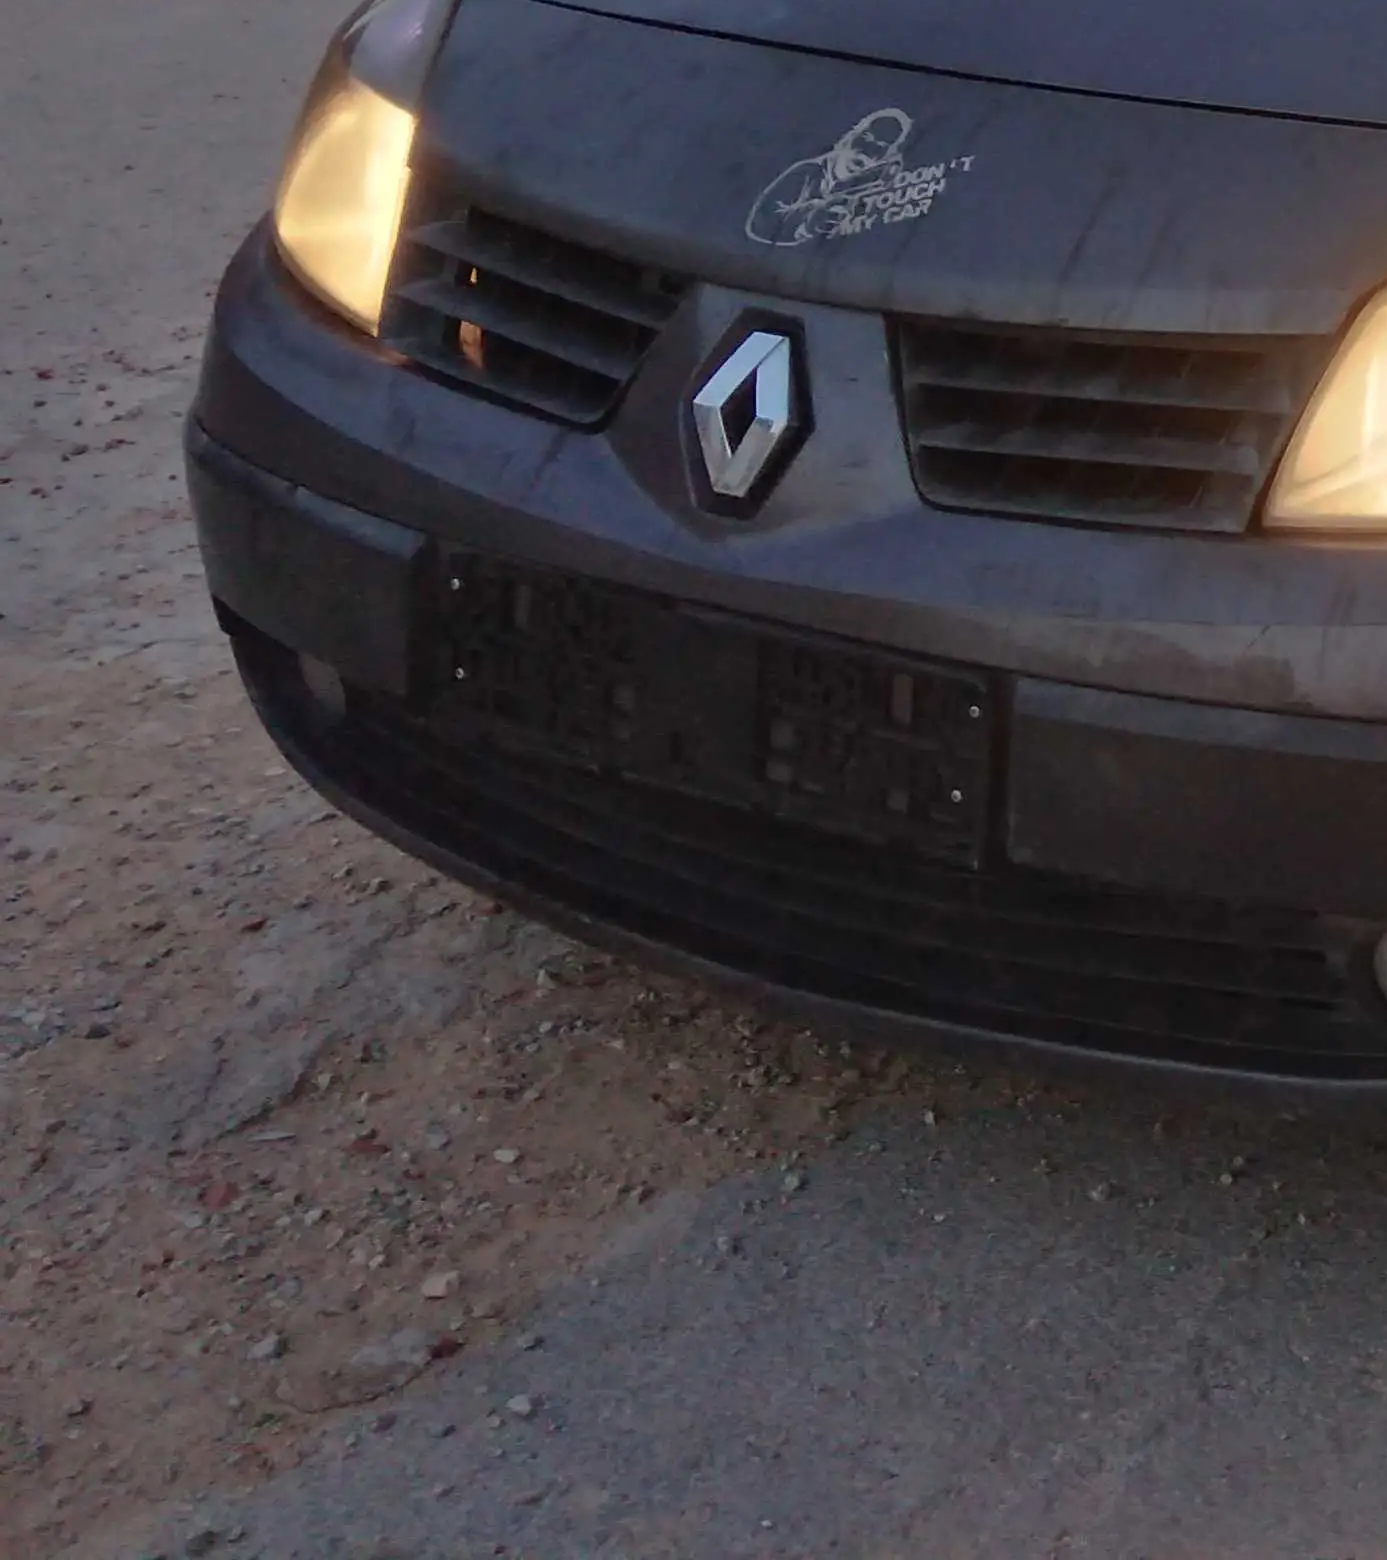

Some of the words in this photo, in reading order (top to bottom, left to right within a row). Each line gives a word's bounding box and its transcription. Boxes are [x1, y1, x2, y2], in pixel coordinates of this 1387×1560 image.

[863, 178, 946, 213] TOUCH
[839, 213, 879, 236] MY
[882, 198, 932, 224] CAR
